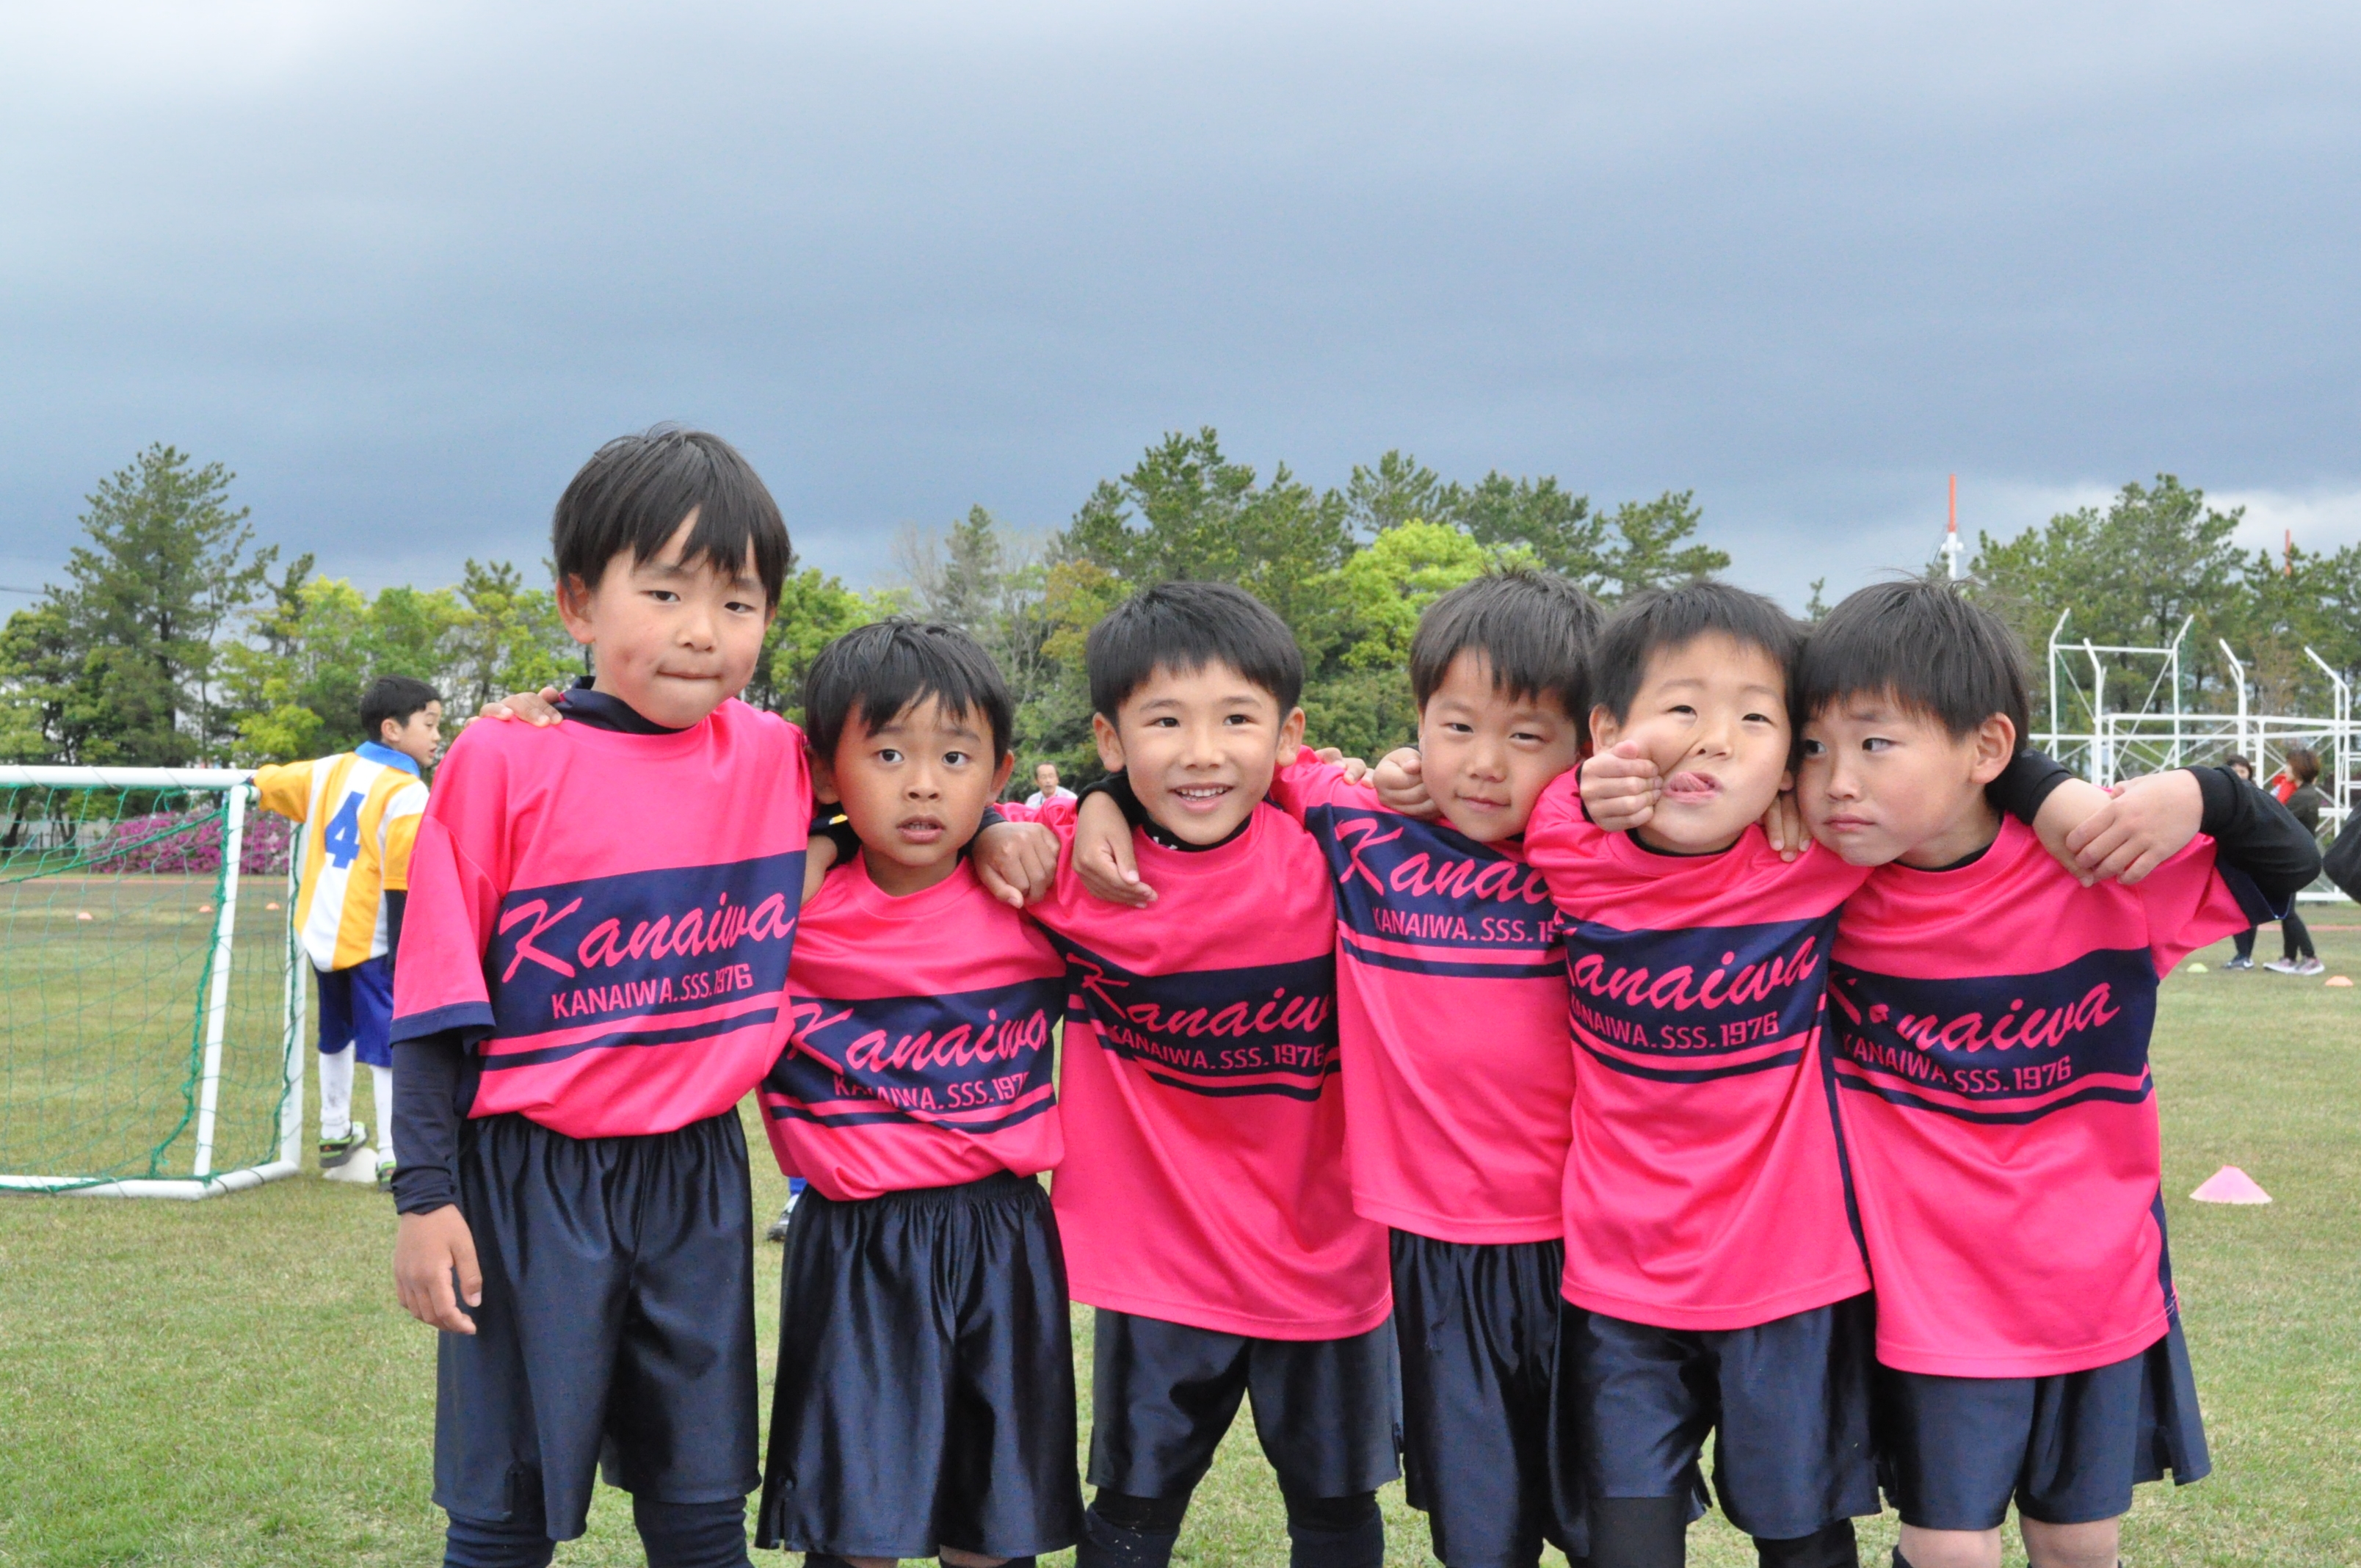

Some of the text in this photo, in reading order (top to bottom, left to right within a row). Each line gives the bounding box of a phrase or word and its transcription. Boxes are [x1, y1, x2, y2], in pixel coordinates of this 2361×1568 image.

[324, 791, 366, 870] 4
[498, 891, 795, 984] Kanaiwa
[1567, 936, 1818, 1011] anaiwa
[1067, 953, 1329, 1037] Kanaiw
